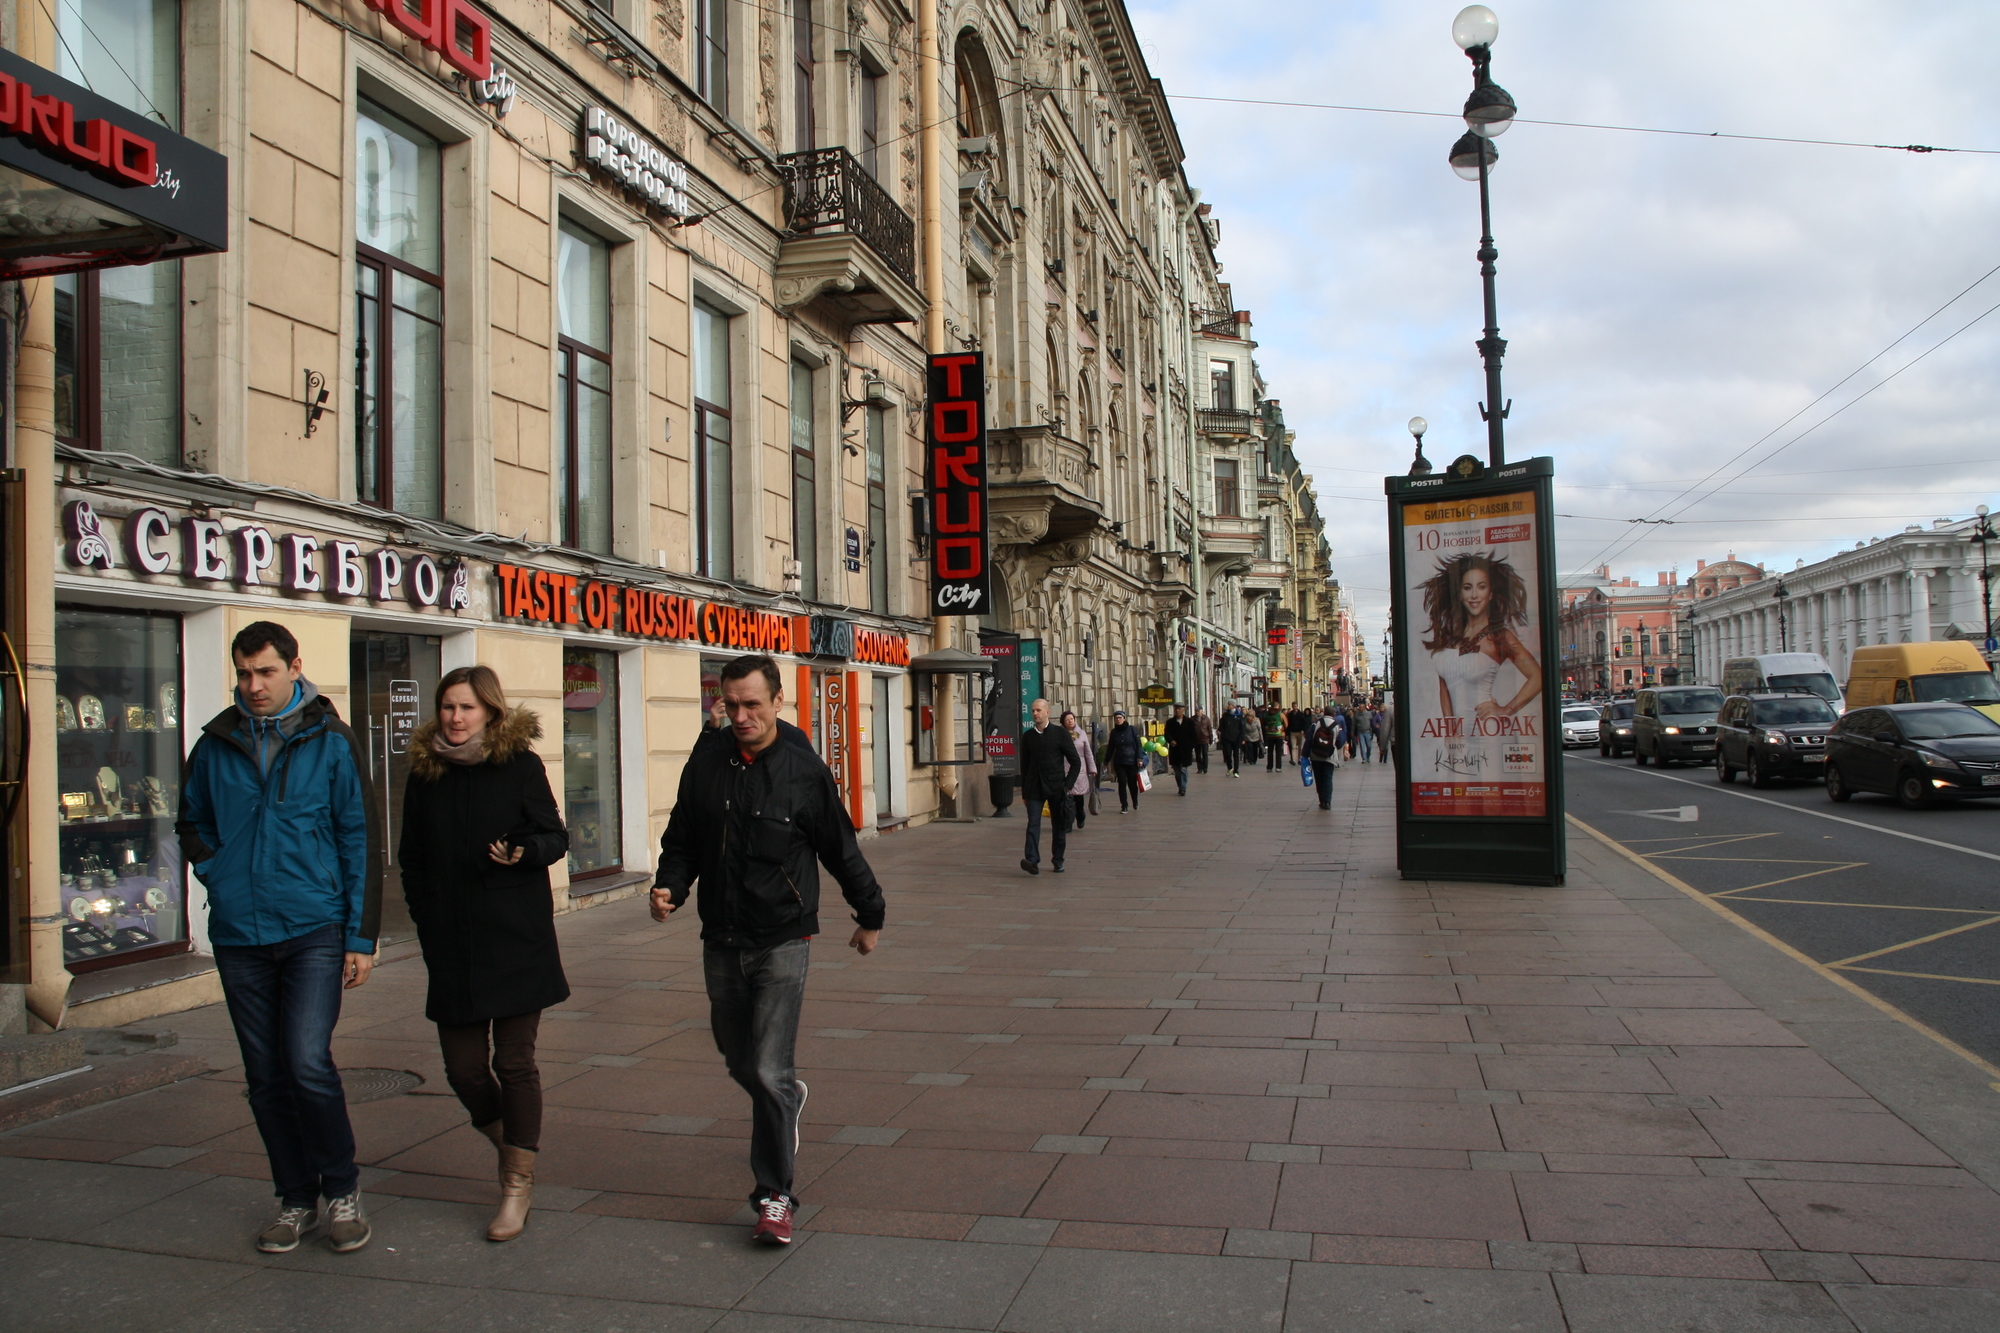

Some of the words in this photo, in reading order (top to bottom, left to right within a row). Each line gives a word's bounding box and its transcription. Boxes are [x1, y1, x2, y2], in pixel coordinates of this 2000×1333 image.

[594, 107, 687, 191] ГОРОДСКОЙ
[594, 136, 688, 217] РЕСТОРАН
[1410, 478, 1444, 488] POSTER
[1498, 467, 1527, 478] POSTER
[1424, 507, 1465, 521] БИЛЕТЫ
[1479, 501, 1523, 515] KASSIR.RU
[1416, 529, 1441, 551] 10
[1490, 526, 1521, 535] ЛЕДОВЫЙ
[1490, 532, 1517, 540] ДВОРЕЦ
[1443, 536, 1481, 548] НОЯБРЯ
[126, 506, 438, 608] СЕРЕБРО
[498, 564, 578, 624] TASTE
[584, 580, 620, 629] OF
[625, 587, 699, 640] RUSSIA
[937, 583, 981, 609] City
[702, 602, 792, 652] СУВЕНИРЫ
[854, 628, 910, 666] SOUVENIRS
[391, 695, 418, 703] СЕРЕБРО
[398, 719, 412, 729] 10-21
[1420, 717, 1465, 738] АНИ
[1470, 715, 1538, 737] ЛОРАК
[1528, 785, 1541, 797] 6+
